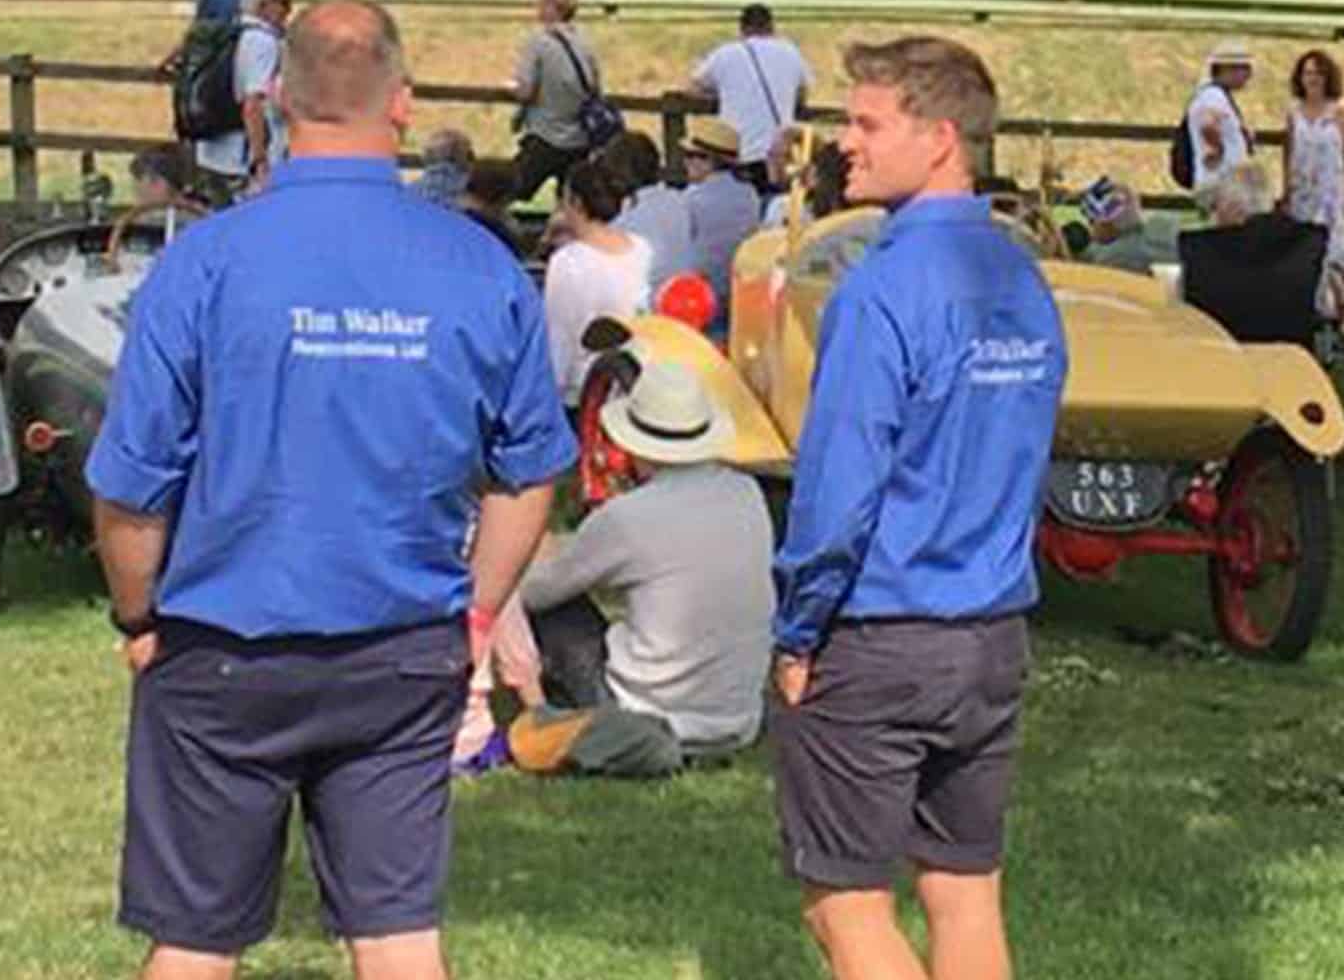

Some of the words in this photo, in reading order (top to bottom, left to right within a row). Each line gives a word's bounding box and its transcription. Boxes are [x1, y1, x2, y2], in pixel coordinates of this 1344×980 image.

[290, 306, 338, 333] Tim
[341, 307, 430, 337] Walker
[1076, 461, 1136, 488] 563
[1069, 489, 1142, 518] UXF
